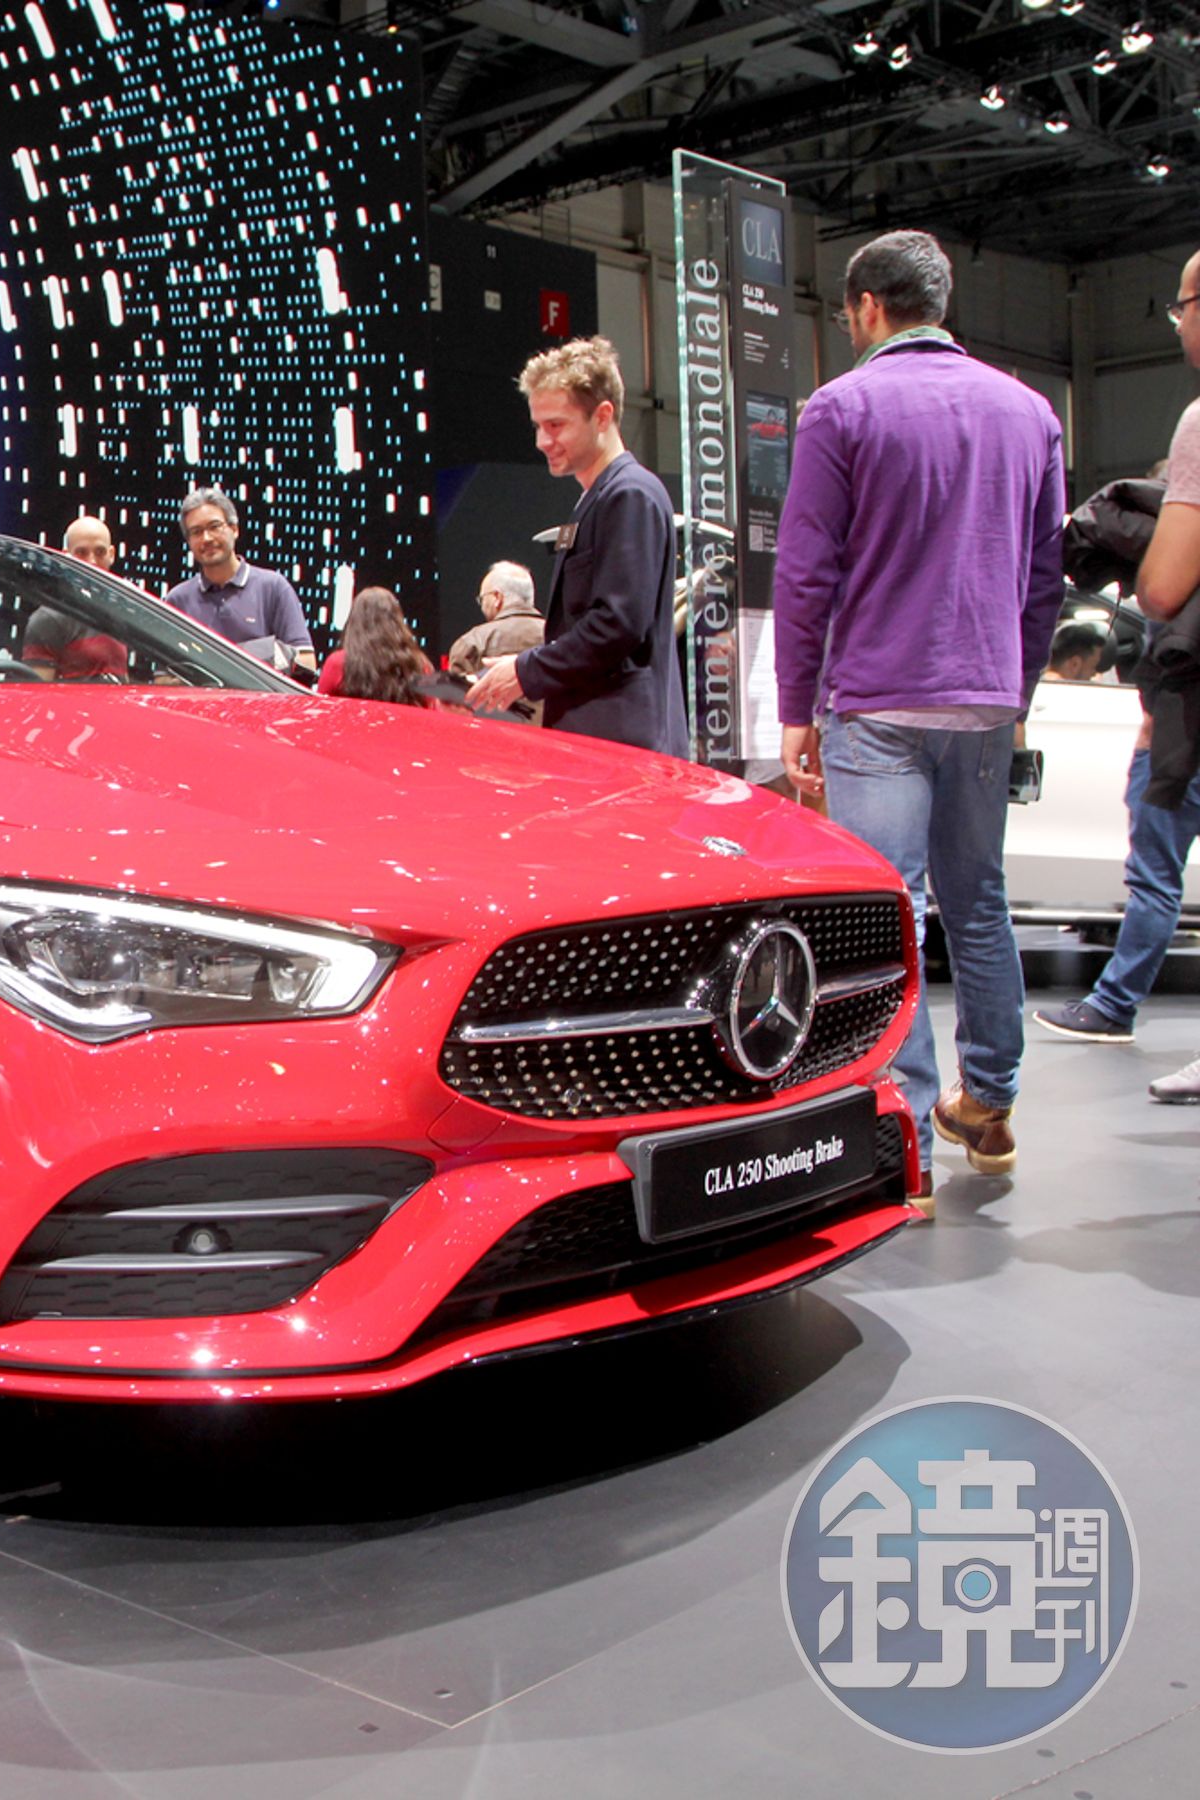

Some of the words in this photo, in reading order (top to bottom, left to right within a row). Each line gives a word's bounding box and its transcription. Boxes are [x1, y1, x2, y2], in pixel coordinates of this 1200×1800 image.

[742, 217, 782, 265] CLA
[547, 300, 561, 328] F
[687, 258, 725, 523] mondiale
[693, 542, 732, 764] remière
[704, 1166, 735, 1196] CLA
[737, 1157, 763, 1186] 250
[764, 1147, 814, 1180] Shooting
[815, 1135, 844, 1165] Brake
